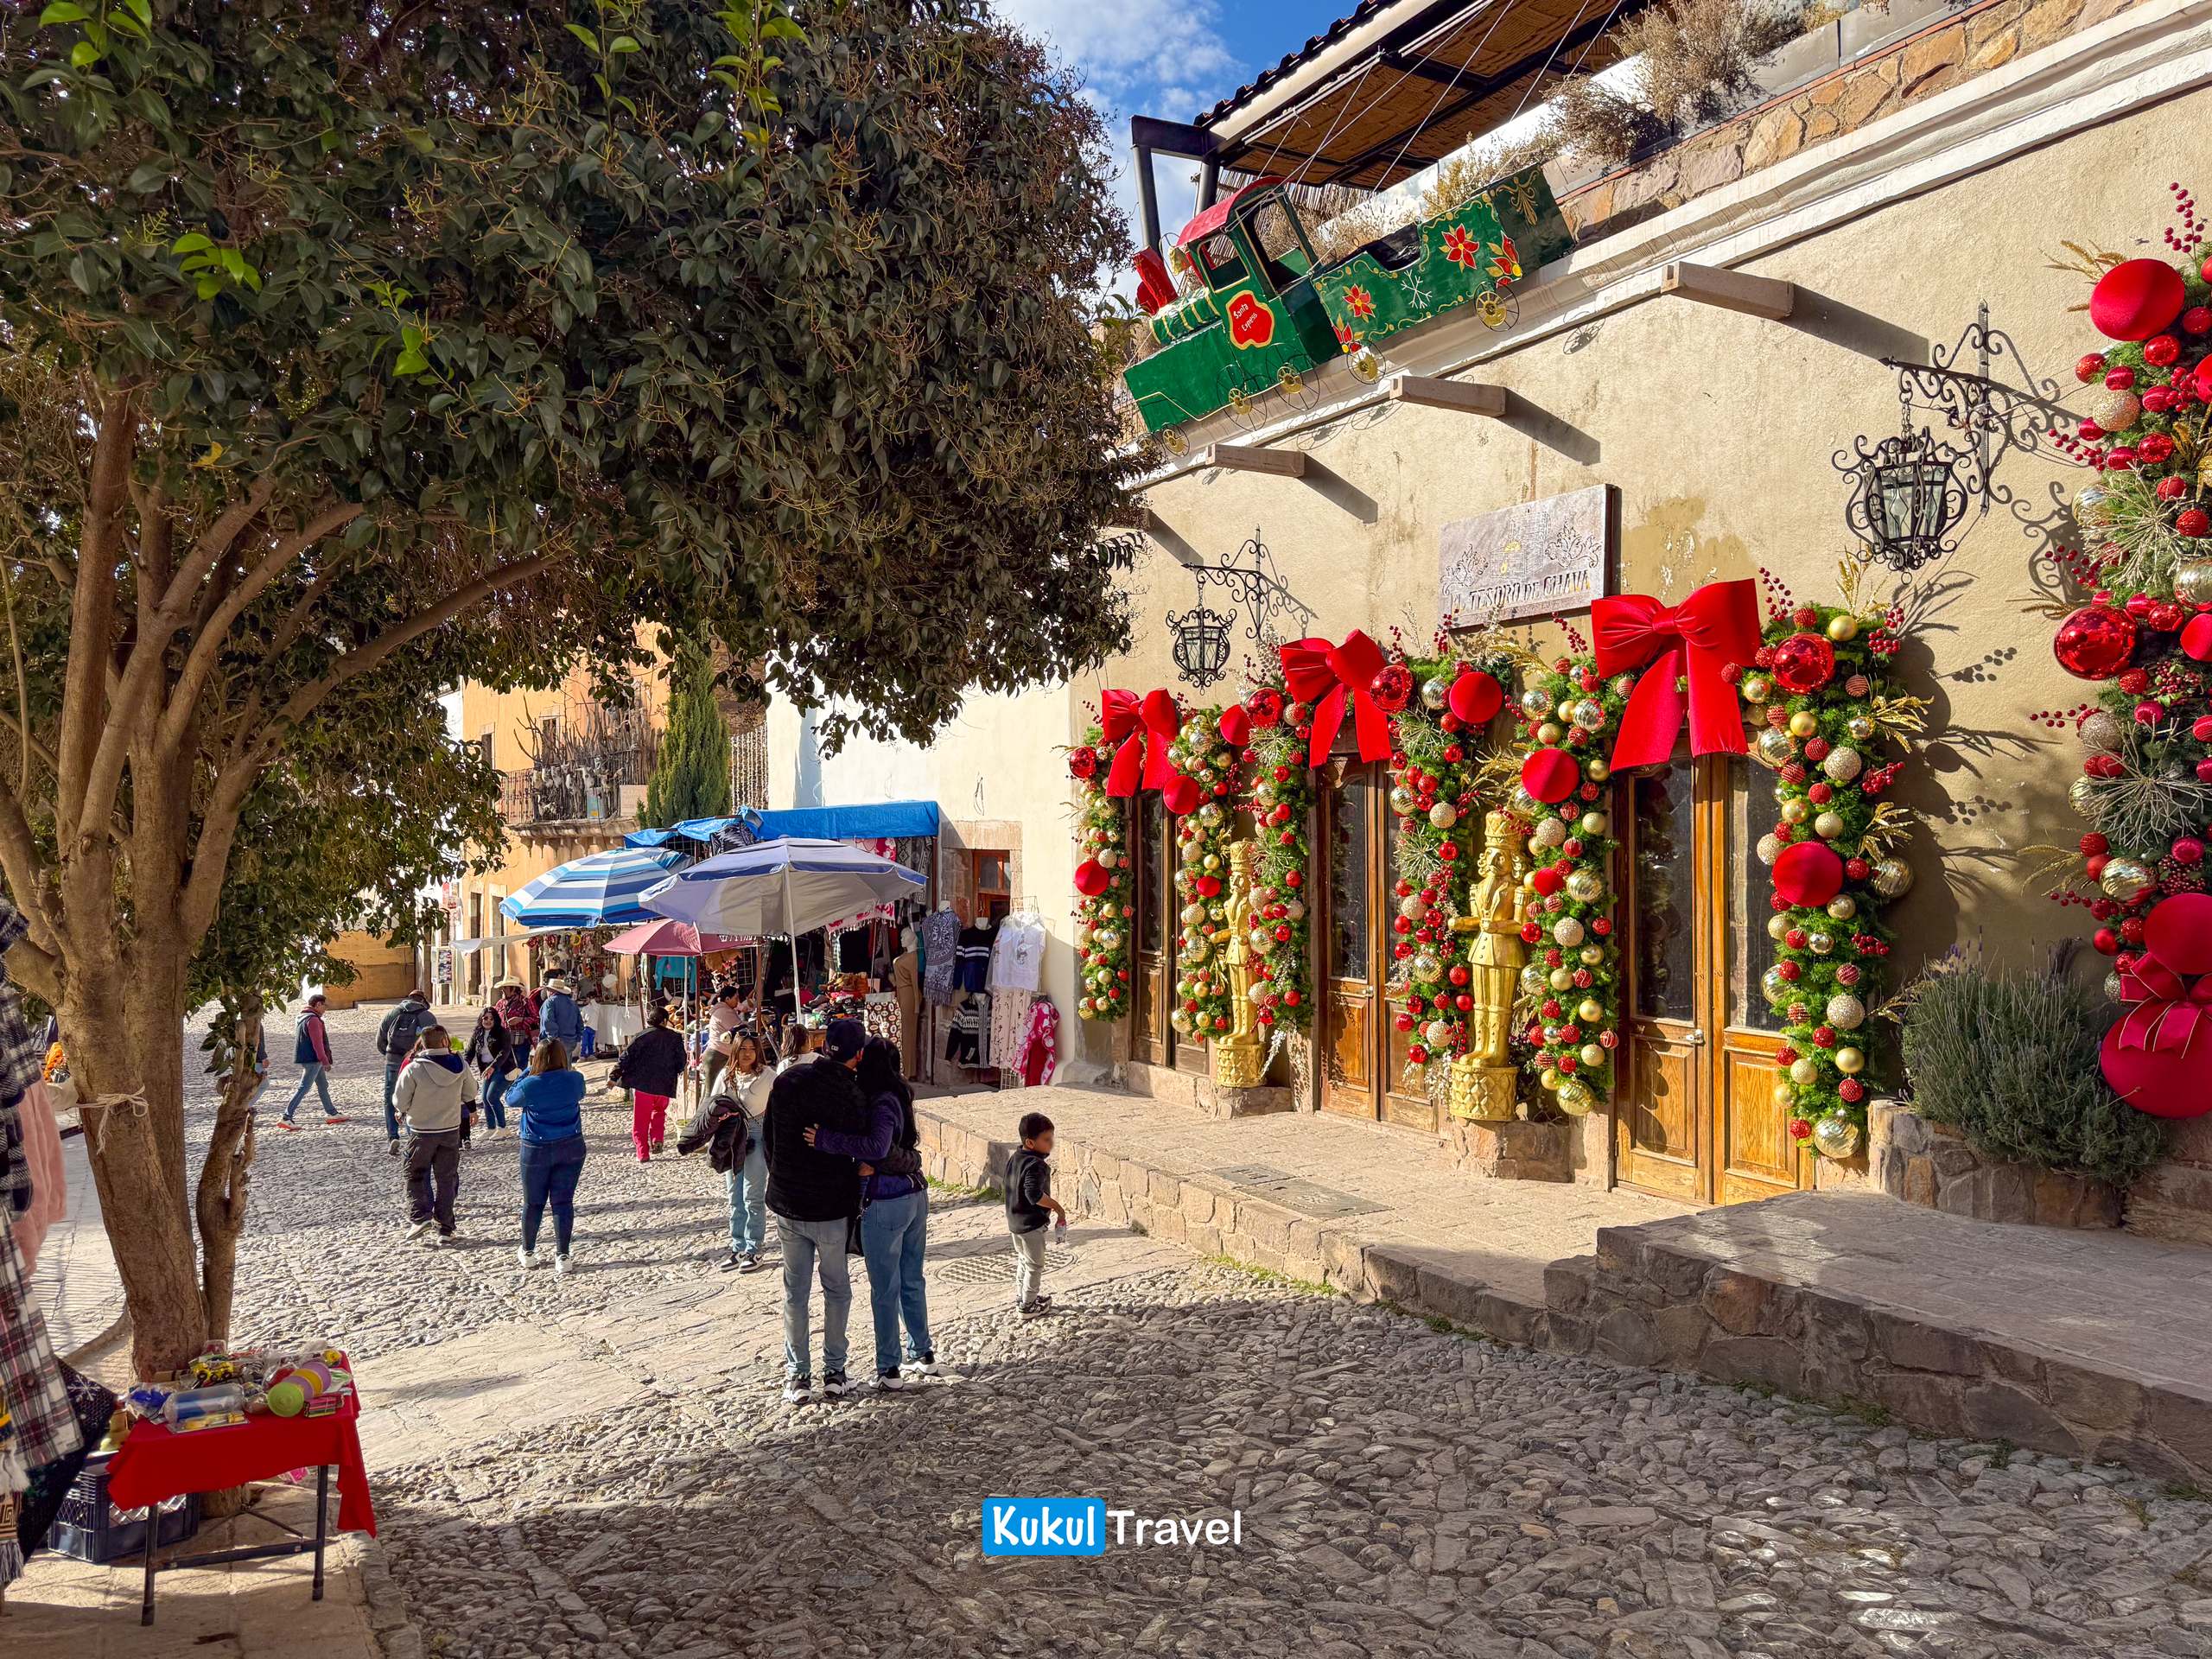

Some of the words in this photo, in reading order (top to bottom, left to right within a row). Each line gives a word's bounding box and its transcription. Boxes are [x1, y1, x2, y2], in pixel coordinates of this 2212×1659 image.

[1233, 303, 1249, 319] Santa
[1470, 582, 1520, 610] TESORO
[1524, 582, 1540, 601] DE
